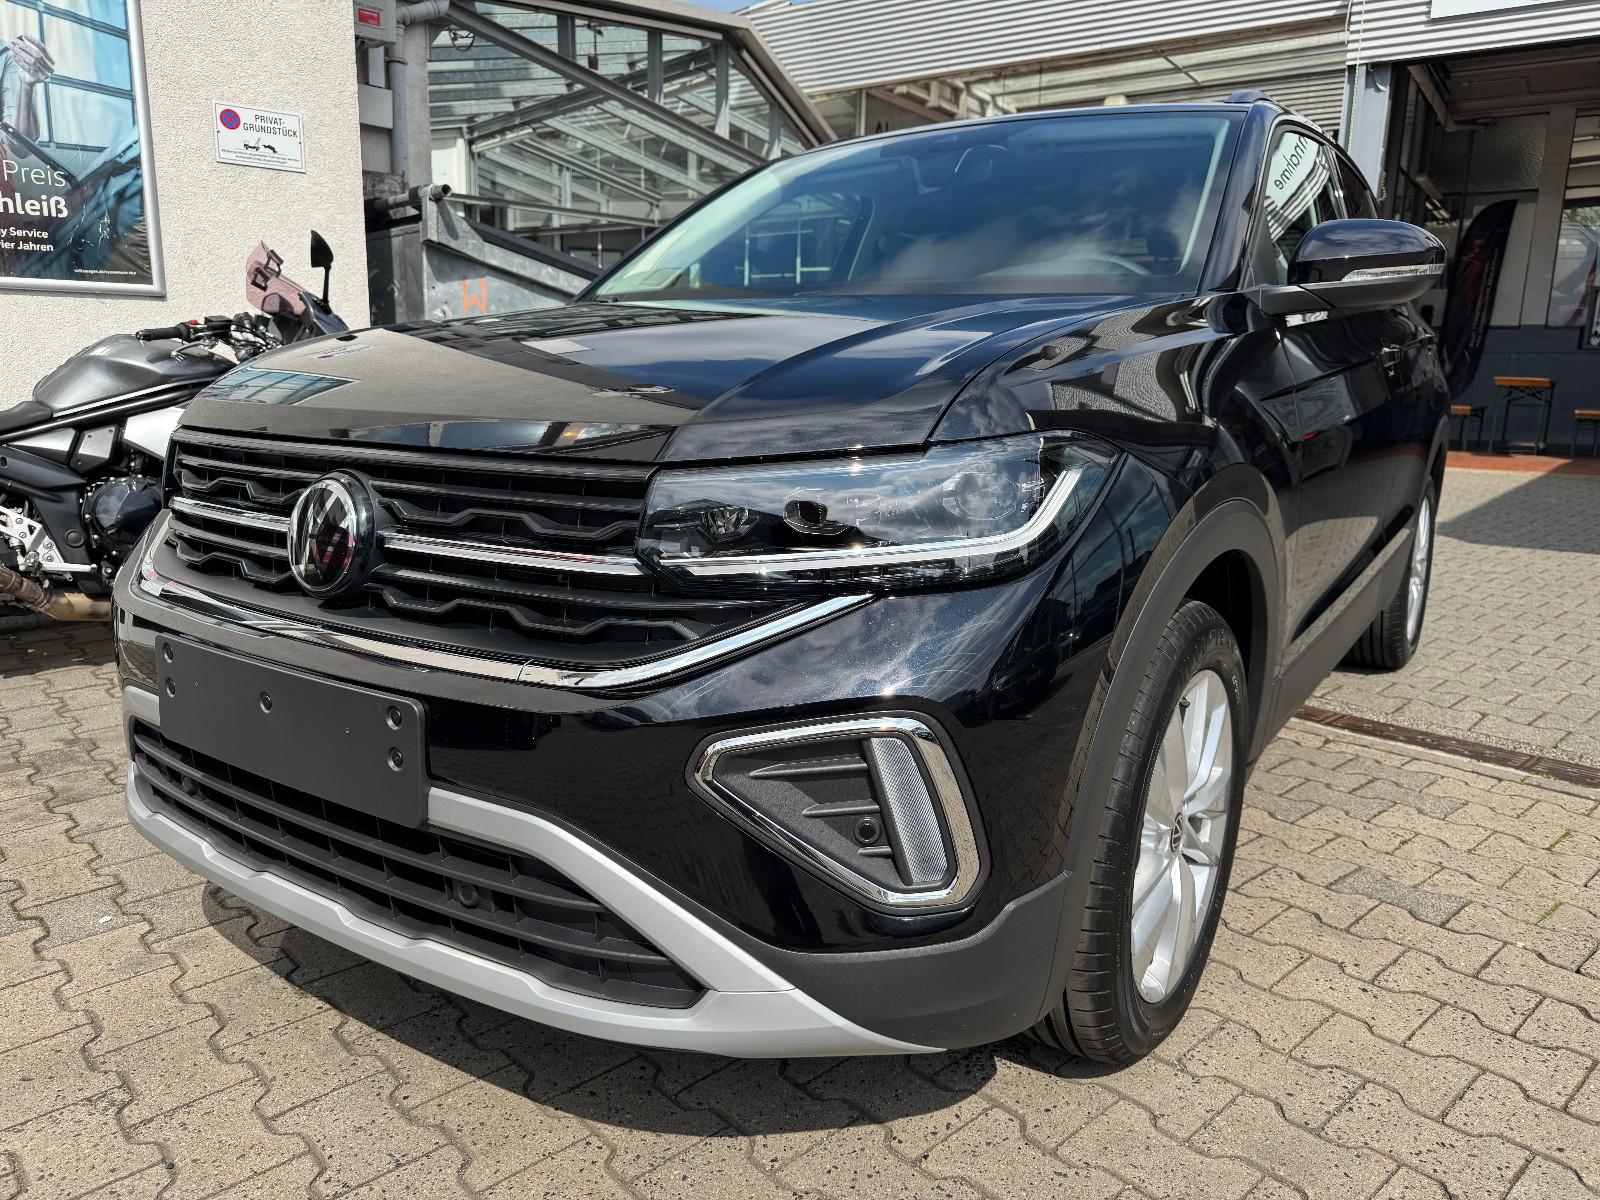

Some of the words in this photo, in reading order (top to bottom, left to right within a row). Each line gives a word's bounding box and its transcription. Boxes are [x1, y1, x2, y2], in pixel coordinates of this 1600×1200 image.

[254, 114, 286, 126] PRIVAT-
[243, 122, 298, 138] GRUNDSTÜCK
[2, 159, 66, 187] Preis
[9, 226, 49, 239] Service
[17, 240, 54, 252] Jahren
